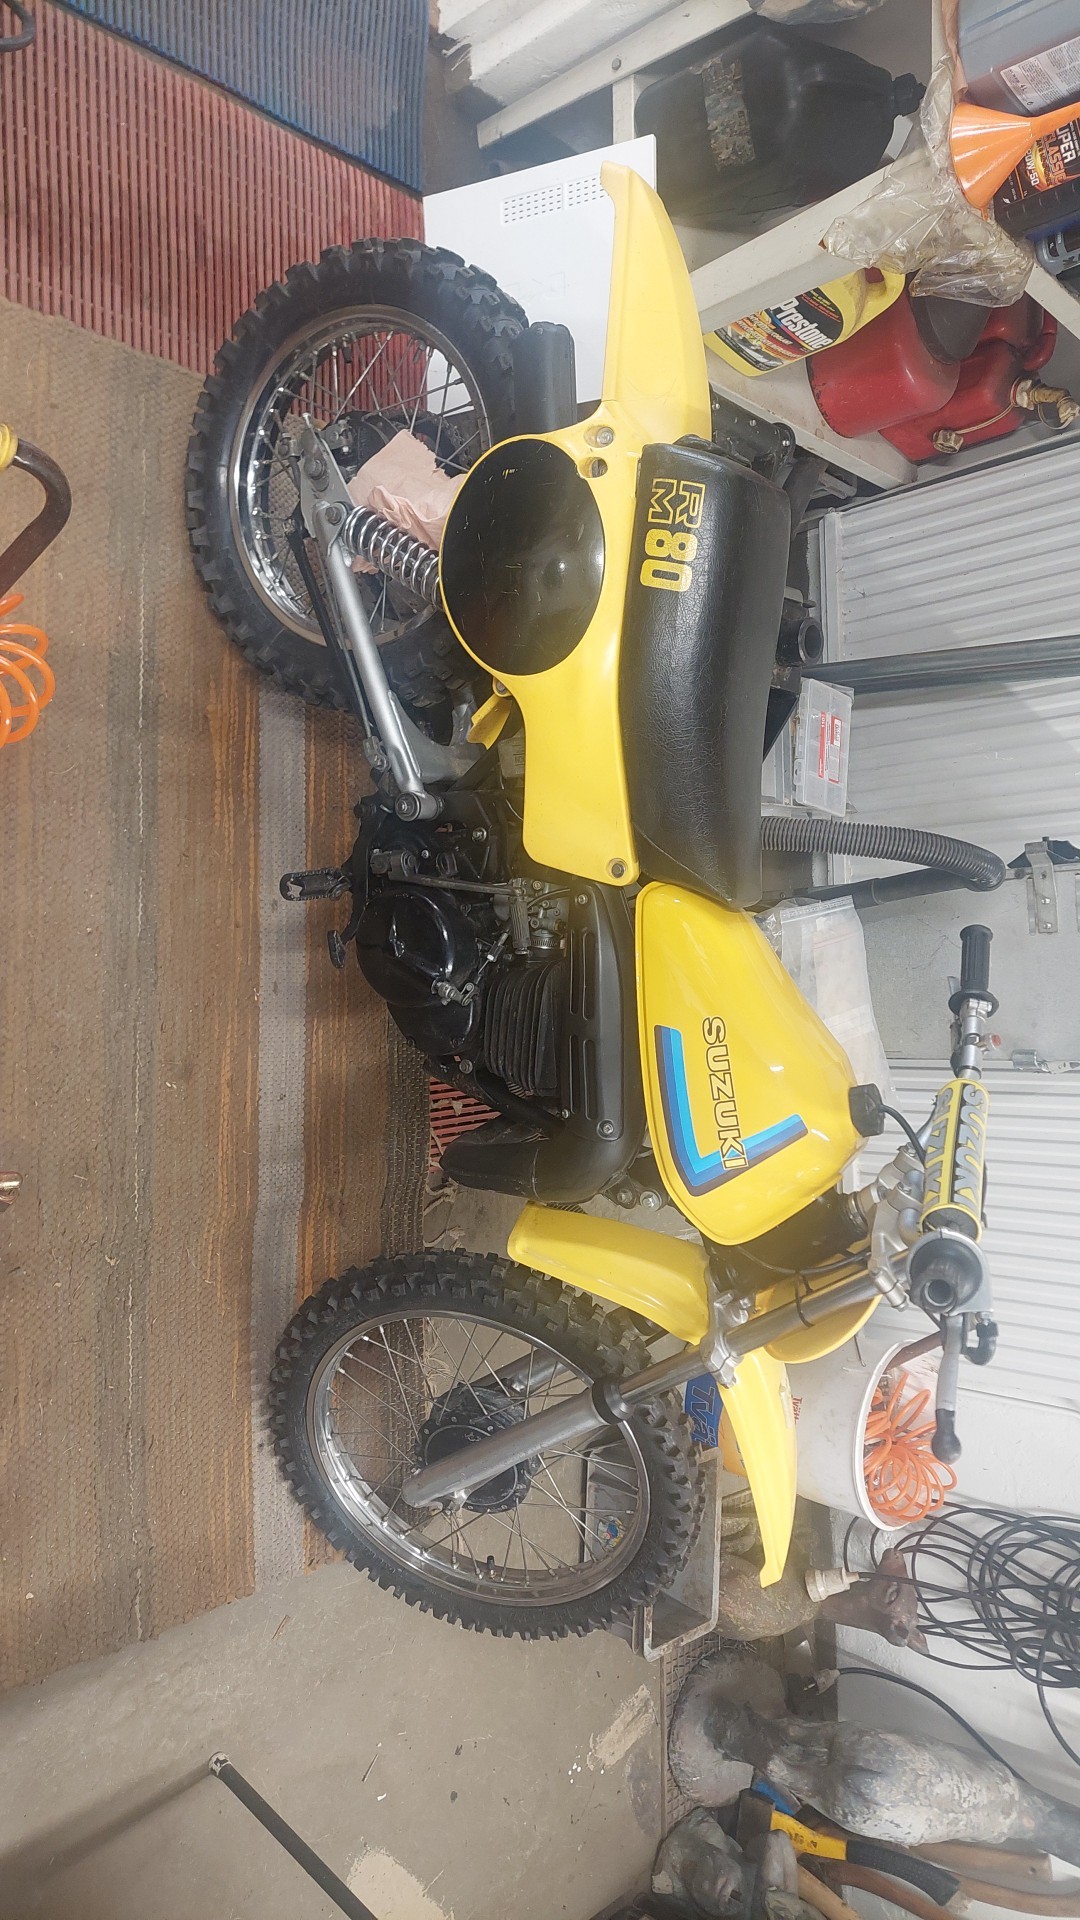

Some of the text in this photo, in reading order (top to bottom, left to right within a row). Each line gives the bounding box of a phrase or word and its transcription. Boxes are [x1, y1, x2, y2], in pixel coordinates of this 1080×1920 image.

[770, 298, 834, 350] Prestone
[640, 528, 698, 592] 80
[702, 1016, 748, 1170] SUZUKI
[953, 1085, 989, 1213] SUZUKI
